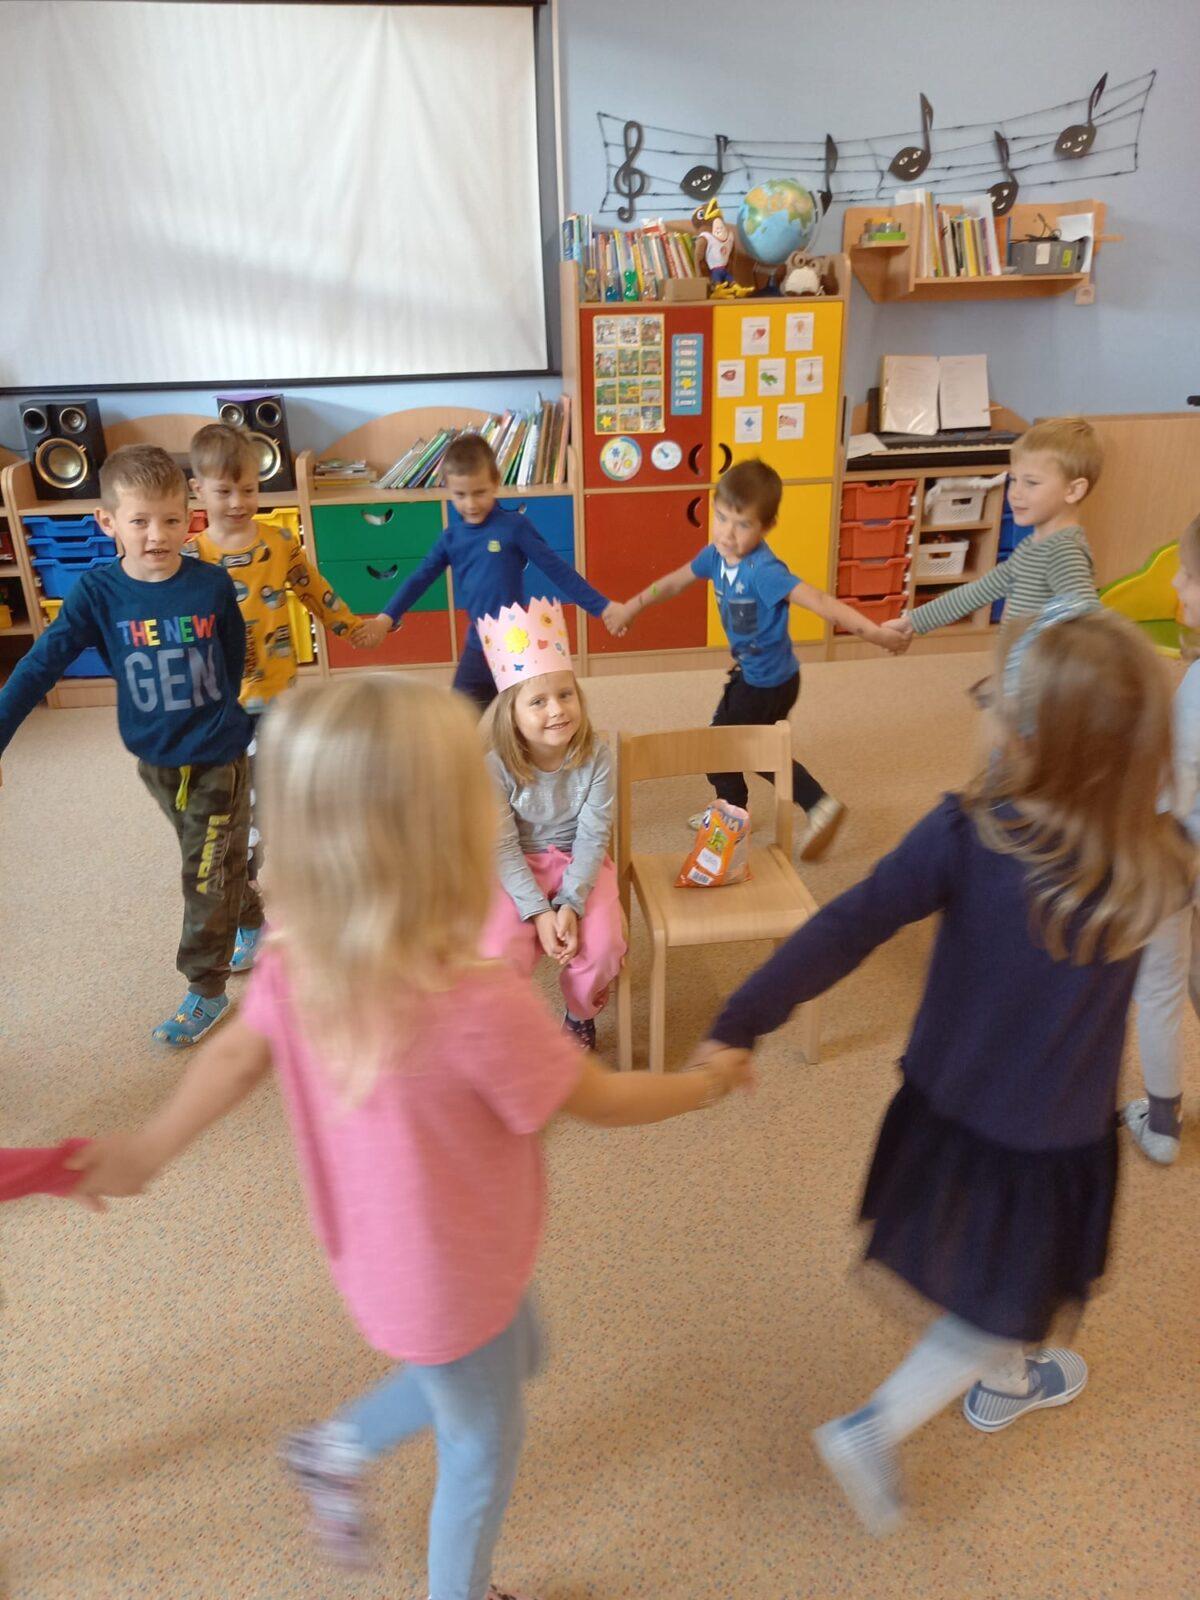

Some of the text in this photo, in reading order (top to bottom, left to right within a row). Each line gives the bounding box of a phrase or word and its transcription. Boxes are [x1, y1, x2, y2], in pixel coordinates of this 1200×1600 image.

[116, 614, 216, 648] THE NEW
[124, 644, 222, 713] GEN
